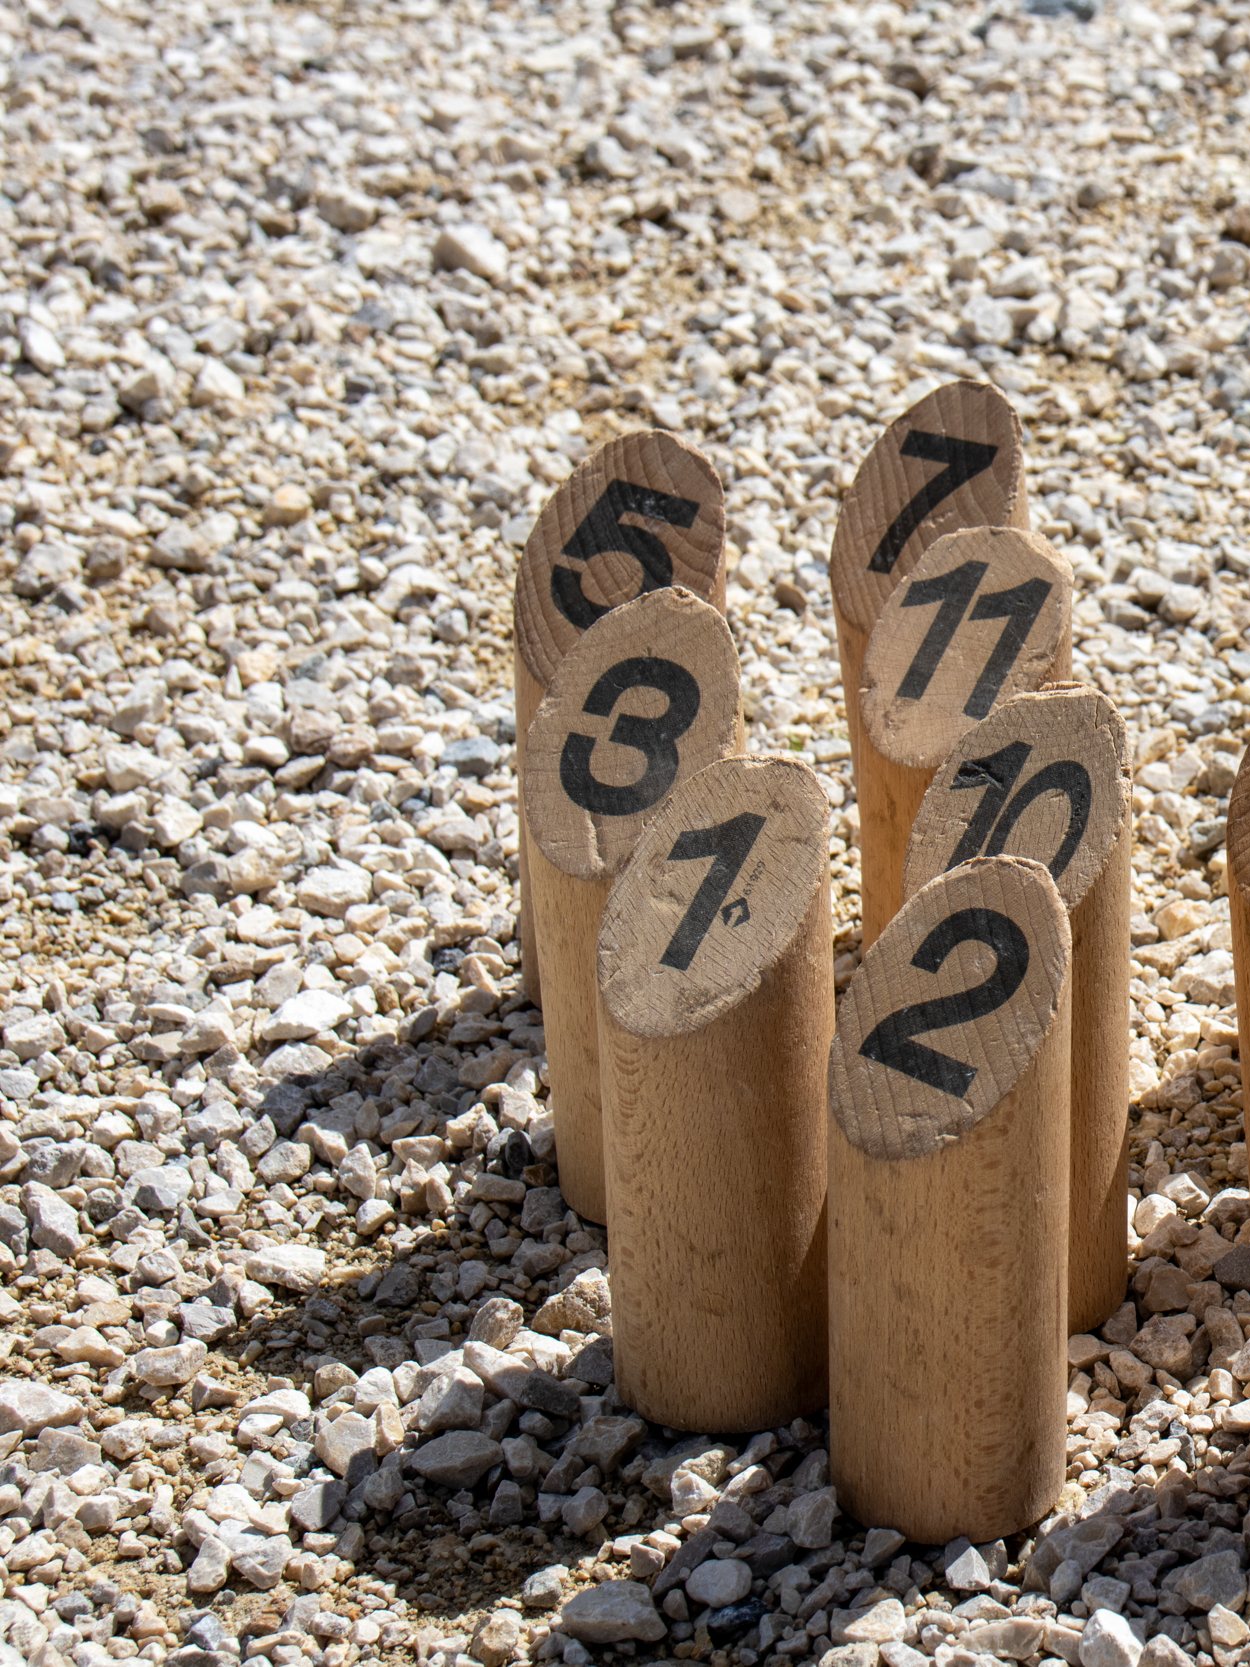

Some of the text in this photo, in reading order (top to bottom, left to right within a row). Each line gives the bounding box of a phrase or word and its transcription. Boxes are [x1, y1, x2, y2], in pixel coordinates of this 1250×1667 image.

[551, 478, 701, 631] 5
[867, 429, 999, 575] 7
[899, 560, 1052, 721] 11
[559, 656, 701, 816] 3
[944, 740, 1092, 882] 10
[660, 811, 767, 972] 1
[858, 907, 1030, 1098] 2
